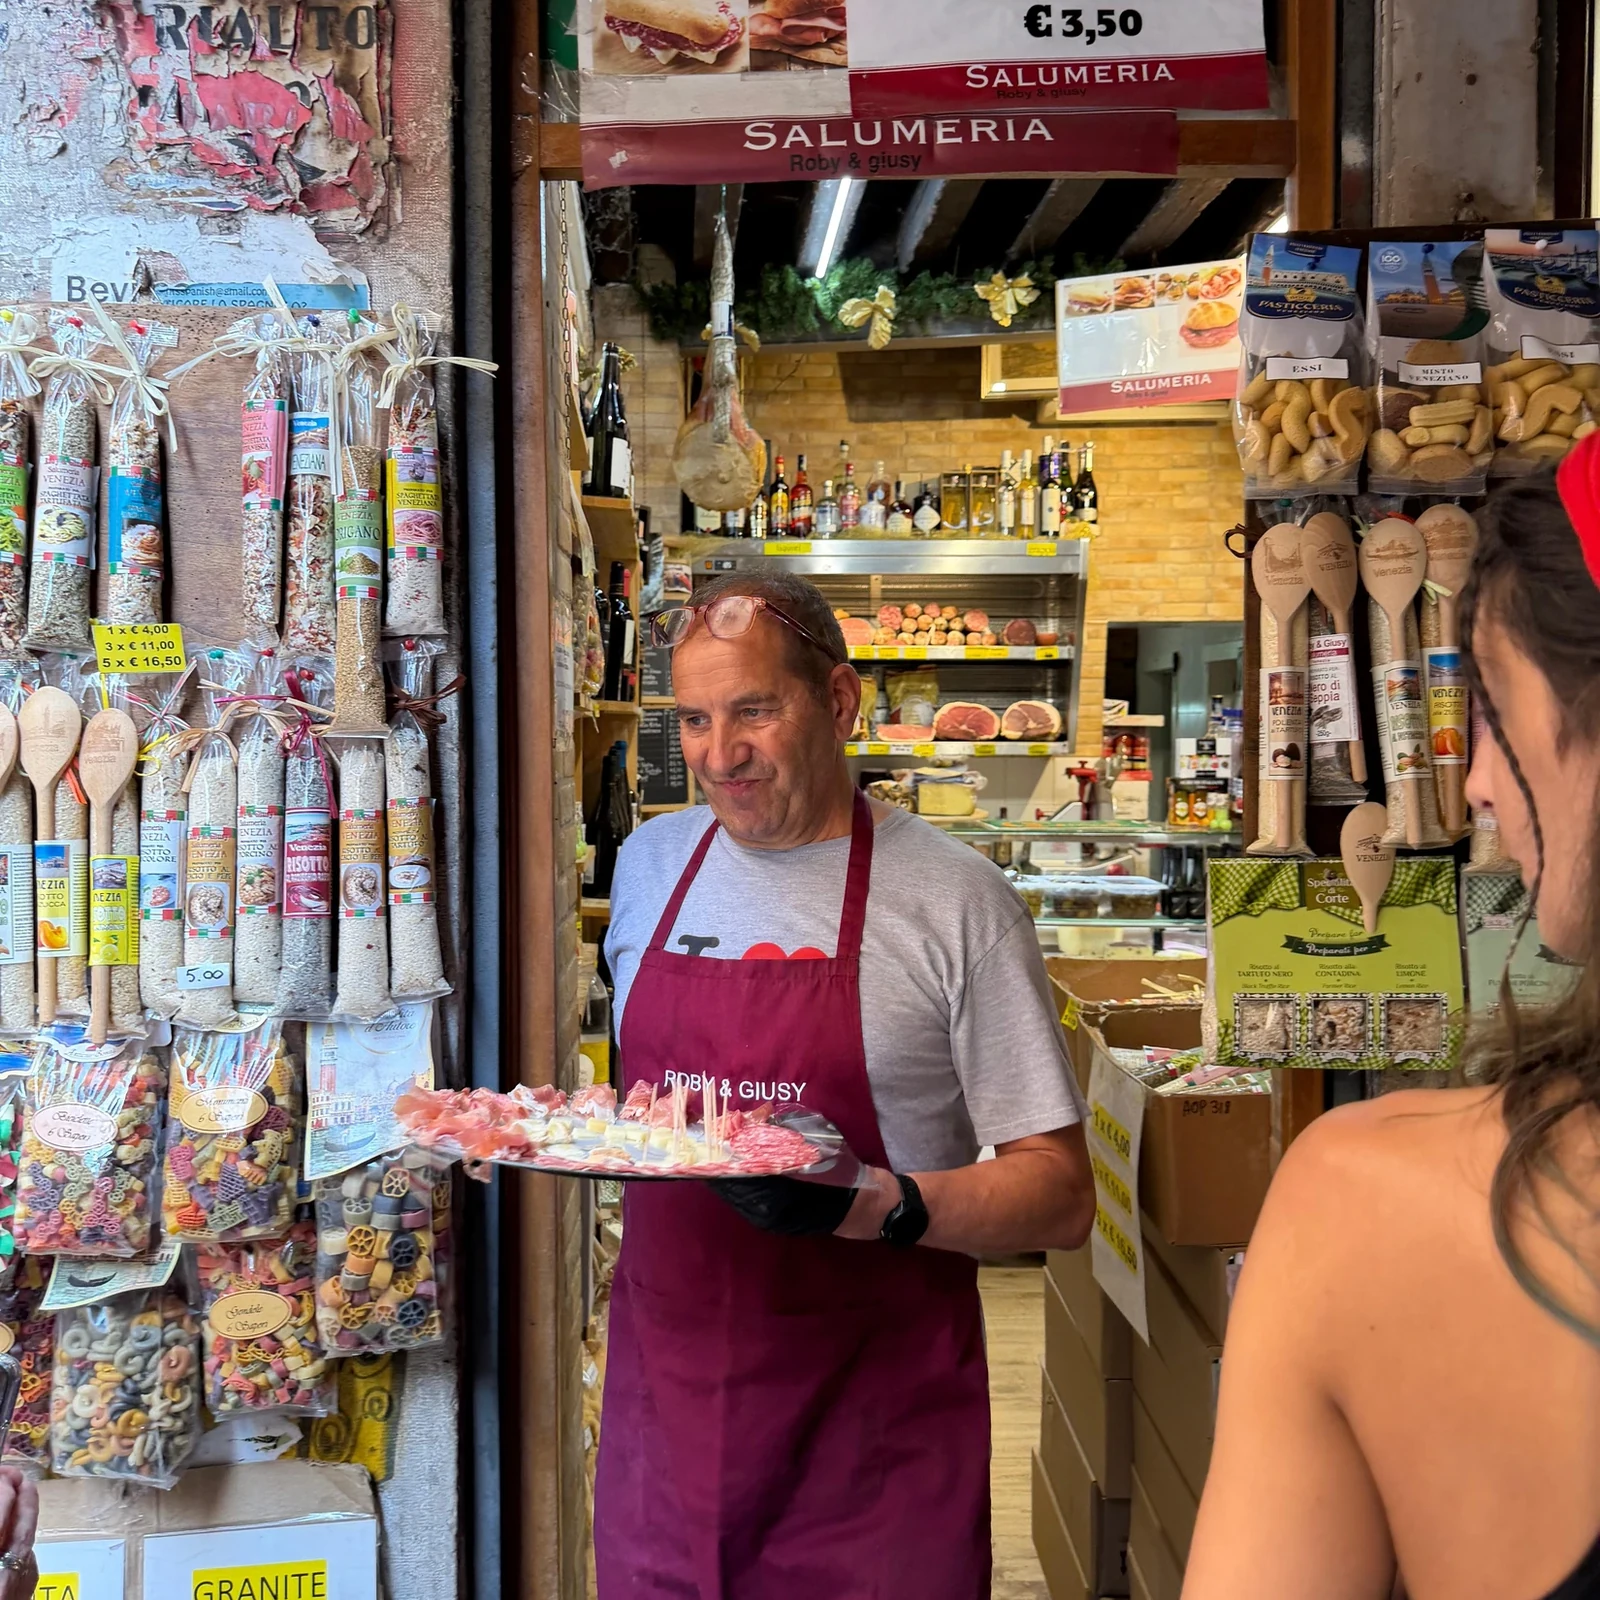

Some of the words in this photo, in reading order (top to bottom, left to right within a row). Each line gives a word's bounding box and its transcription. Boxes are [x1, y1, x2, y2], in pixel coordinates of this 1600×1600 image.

[155, 4, 376, 50] RIALTO
[1024, 4, 1053, 38] €
[1061, 9, 1143, 45] 3,50
[966, 63, 1175, 88] SALUMERIA
[997, 90, 1032, 99] Roby
[1036, 88, 1046, 97] &
[743, 119, 1055, 150] SALUMERIA
[790, 154, 841, 174] Roby
[847, 152, 861, 169] &
[868, 151, 922, 173] giusy
[1258, 300, 1343, 311] PASTICCERIA
[1292, 364, 1322, 373] ESSI
[1110, 374, 1212, 393] SALUMERIA
[1409, 374, 1470, 382] VENEZIANO
[43, 475, 86, 487] VENEZIA
[1373, 565, 1413, 578] Venezia
[107, 626, 114, 635] 1
[131, 625, 139, 635] €
[142, 625, 169, 636] 4,00
[105, 642, 113, 651] 3
[117, 643, 126, 651] x
[129, 641, 137, 650] €
[141, 641, 175, 651] 11,00
[1324, 639, 1347, 650] Giusy
[102, 658, 111, 667] 5
[116, 660, 125, 668] x
[129, 657, 138, 667] €
[143, 656, 182, 668] 16,50
[1310, 684, 1327, 692] ero
[1331, 680, 1341, 691] di
[240, 828, 273, 837] ENEZIA
[289, 842, 327, 851] Venezia
[192, 850, 227, 859] ENEZIA
[286, 855, 330, 873] RISOTTO
[37, 879, 65, 890] NEZIA
[39, 892, 65, 900] OTTO
[93, 892, 122, 902] NEZIA
[1316, 893, 1349, 904] Corte
[1309, 928, 1346, 939] Prepare
[1306, 943, 1351, 956] Preparati
[1354, 945, 1369, 955] per
[186, 967, 224, 983] 5.00
[664, 1069, 716, 1092] ROBY
[719, 1078, 732, 1098] &
[738, 1080, 807, 1101] GIUSY
[193, 1571, 326, 1600] GRANITE
